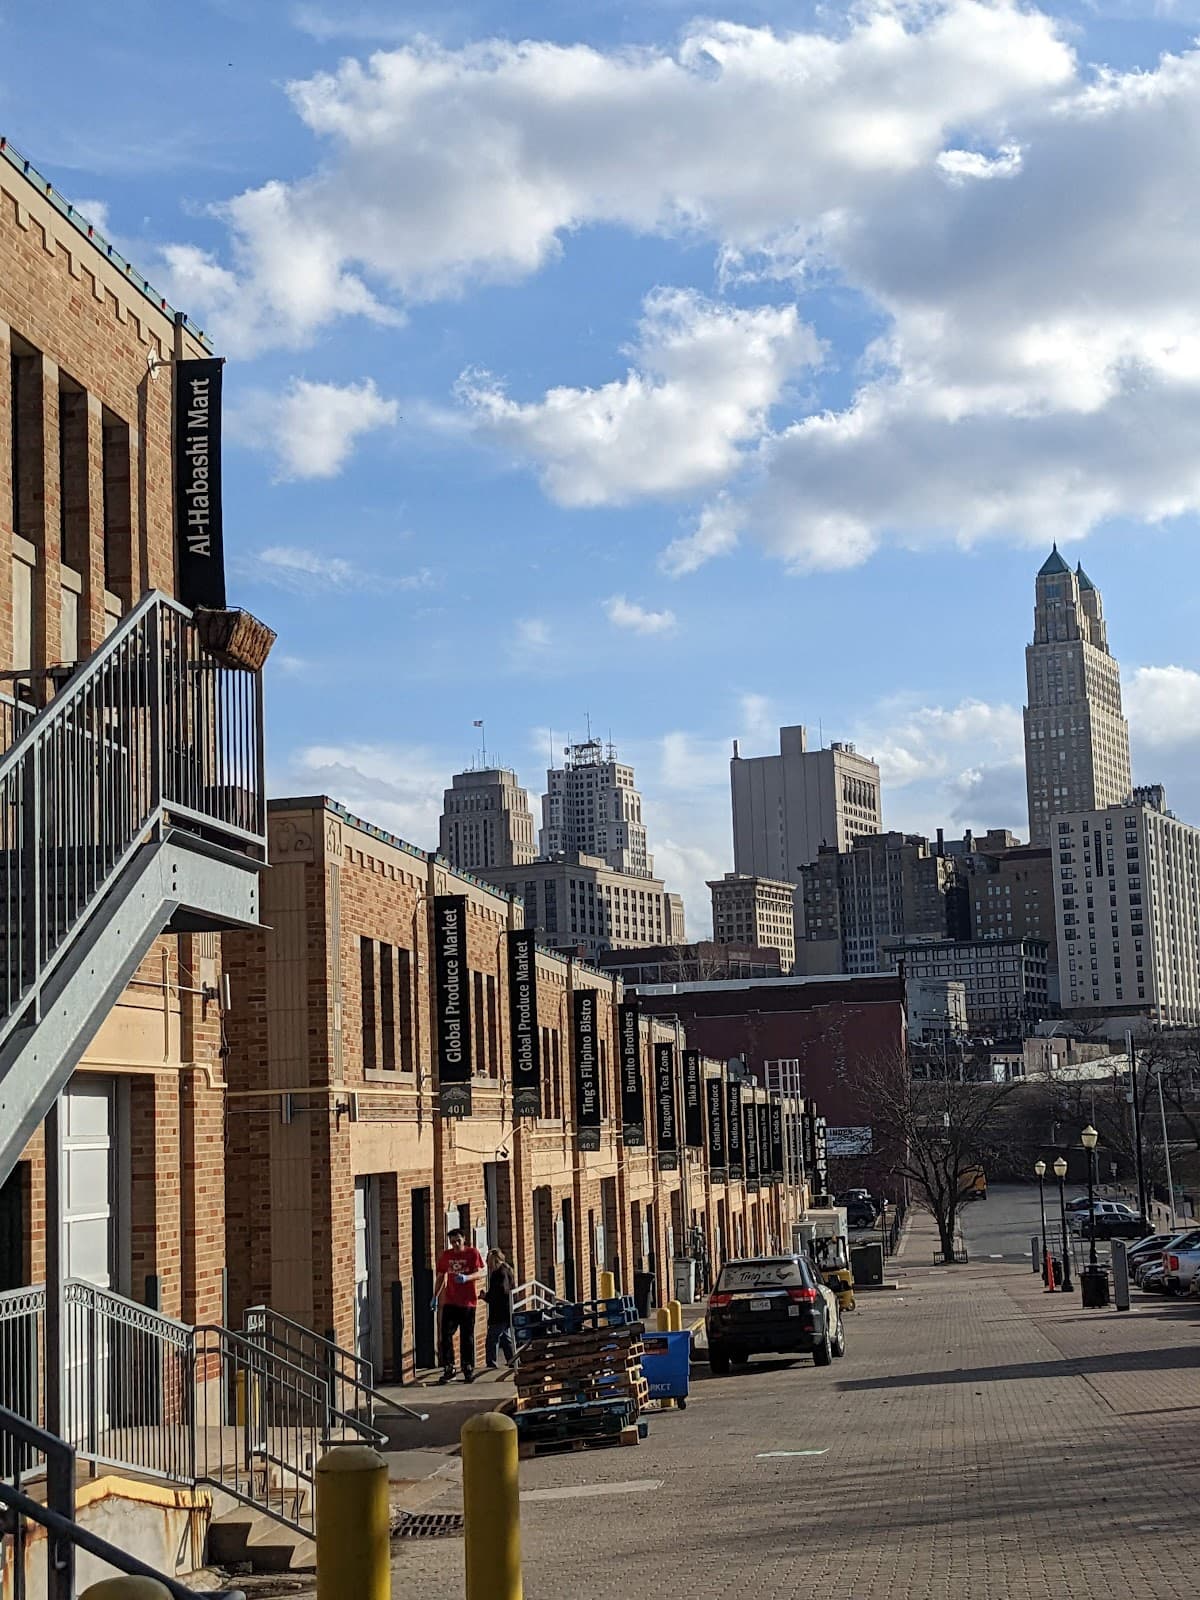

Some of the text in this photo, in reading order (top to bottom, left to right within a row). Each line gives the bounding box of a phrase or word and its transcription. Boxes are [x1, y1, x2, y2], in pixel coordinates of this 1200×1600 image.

[186, 378, 210, 557] Al-Habashi Mart
[442, 908, 461, 1063] Global Produce Market
[515, 941, 533, 1072] Global Produce Market
[580, 999, 596, 1115] Ting's Filipino Bistro
[623, 1011, 637, 1093] Burrito Brothers
[687, 1056, 698, 1107] Tikka House
[447, 1104, 465, 1114] 401
[520, 1106, 535, 1114] 403
[659, 1049, 673, 1138] Dragonfly Tea Zone
[710, 1084, 721, 1151] Cristina's Produce
[729, 1087, 738, 1116] Produce
